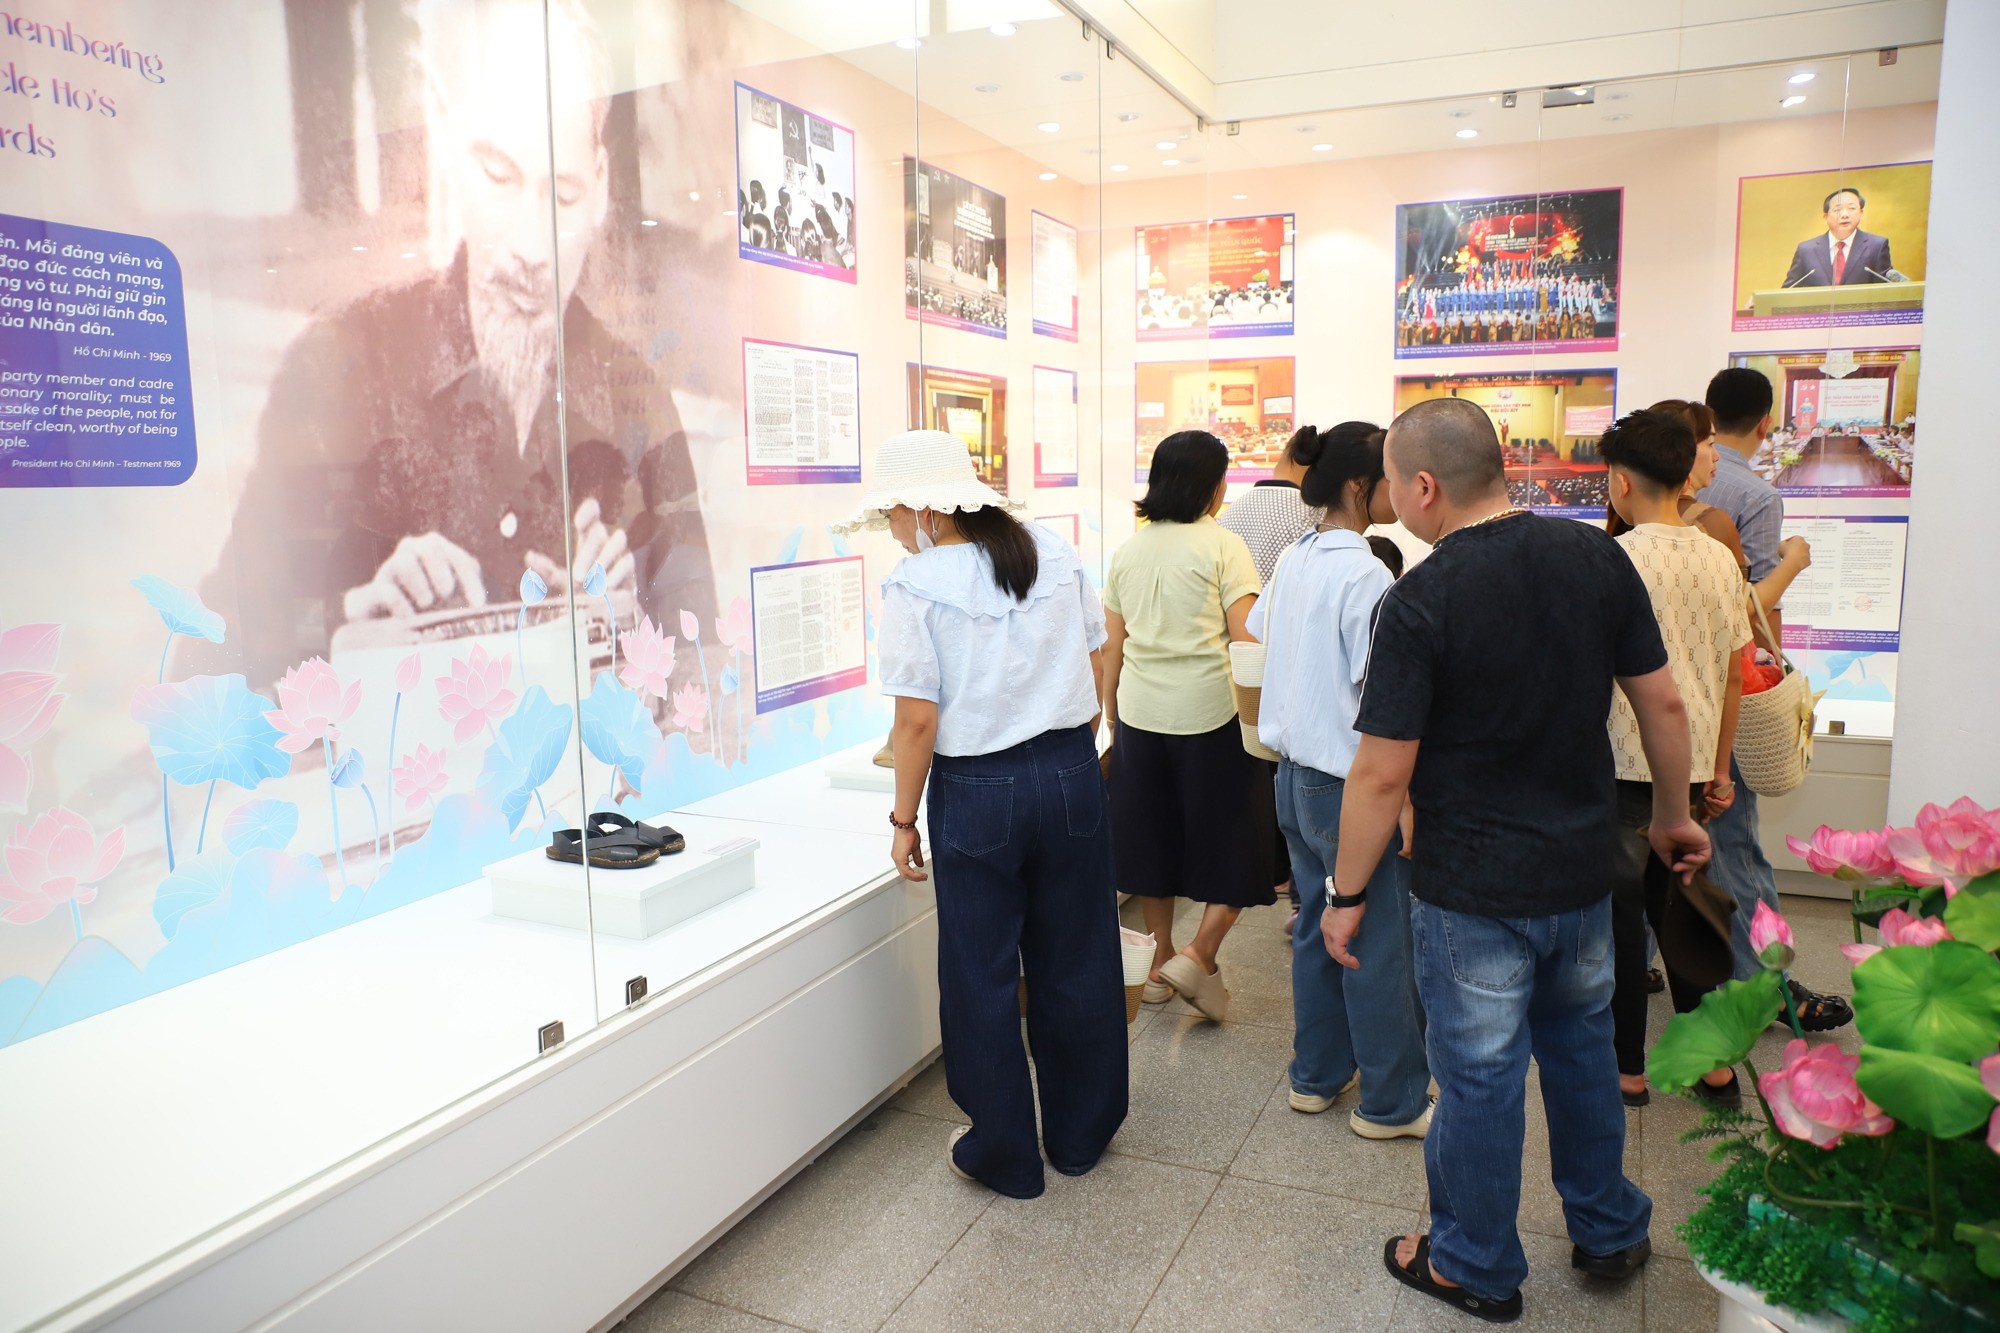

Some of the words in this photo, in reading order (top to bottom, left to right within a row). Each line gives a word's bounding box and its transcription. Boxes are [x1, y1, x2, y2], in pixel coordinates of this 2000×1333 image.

[52, 78, 117, 118] Ho's
[25, 238, 57, 255] Mỗi
[61, 244, 104, 264] đảng
[109, 252, 141, 267] viên
[145, 257, 163, 270] và
[35, 259, 67, 275] đức
[72, 266, 111, 281] cách
[116, 272, 165, 290] mạng,
[25, 278, 46, 292] vô
[50, 281, 71, 295] tư.
[75, 283, 112, 299] Phải
[115, 289, 141, 304] giữ
[142, 293, 166, 307] gìn
[37, 297, 53, 312] là
[55, 301, 100, 317] người
[102, 305, 135, 320] lãnh
[137, 310, 168, 325] đạo,
[29, 316, 76, 333] Nhân
[80, 321, 115, 337] dân.
[73, 345, 90, 356] Hồ
[92, 346, 111, 358] Chí
[113, 348, 140, 360] Minh
[149, 351, 172, 362] 1969
[2, 370, 42, 385] party
[46, 373, 106, 386] member
[109, 376, 135, 388] and
[138, 379, 174, 390] cadre
[52, 389, 113, 404] morality;
[120, 393, 152, 404] must
[160, 394, 176, 405] be
[5, 403, 40, 415] sake
[43, 404, 59, 416] of
[60, 405, 83, 417] the
[86, 408, 133, 420] people,
[136, 408, 157, 419] not
[160, 408, 177, 420] for
[34, 420, 76, 434] clean,
[79, 422, 126, 436] worthy
[128, 422, 142, 434] of
[143, 423, 178, 437] being
[12, 459, 58, 468] President
[60, 460, 73, 468] Ho
[75, 460, 91, 468] Chi
[92, 460, 115, 468] Minh
[123, 460, 162, 468] Testment
[163, 460, 182, 468] 1969
